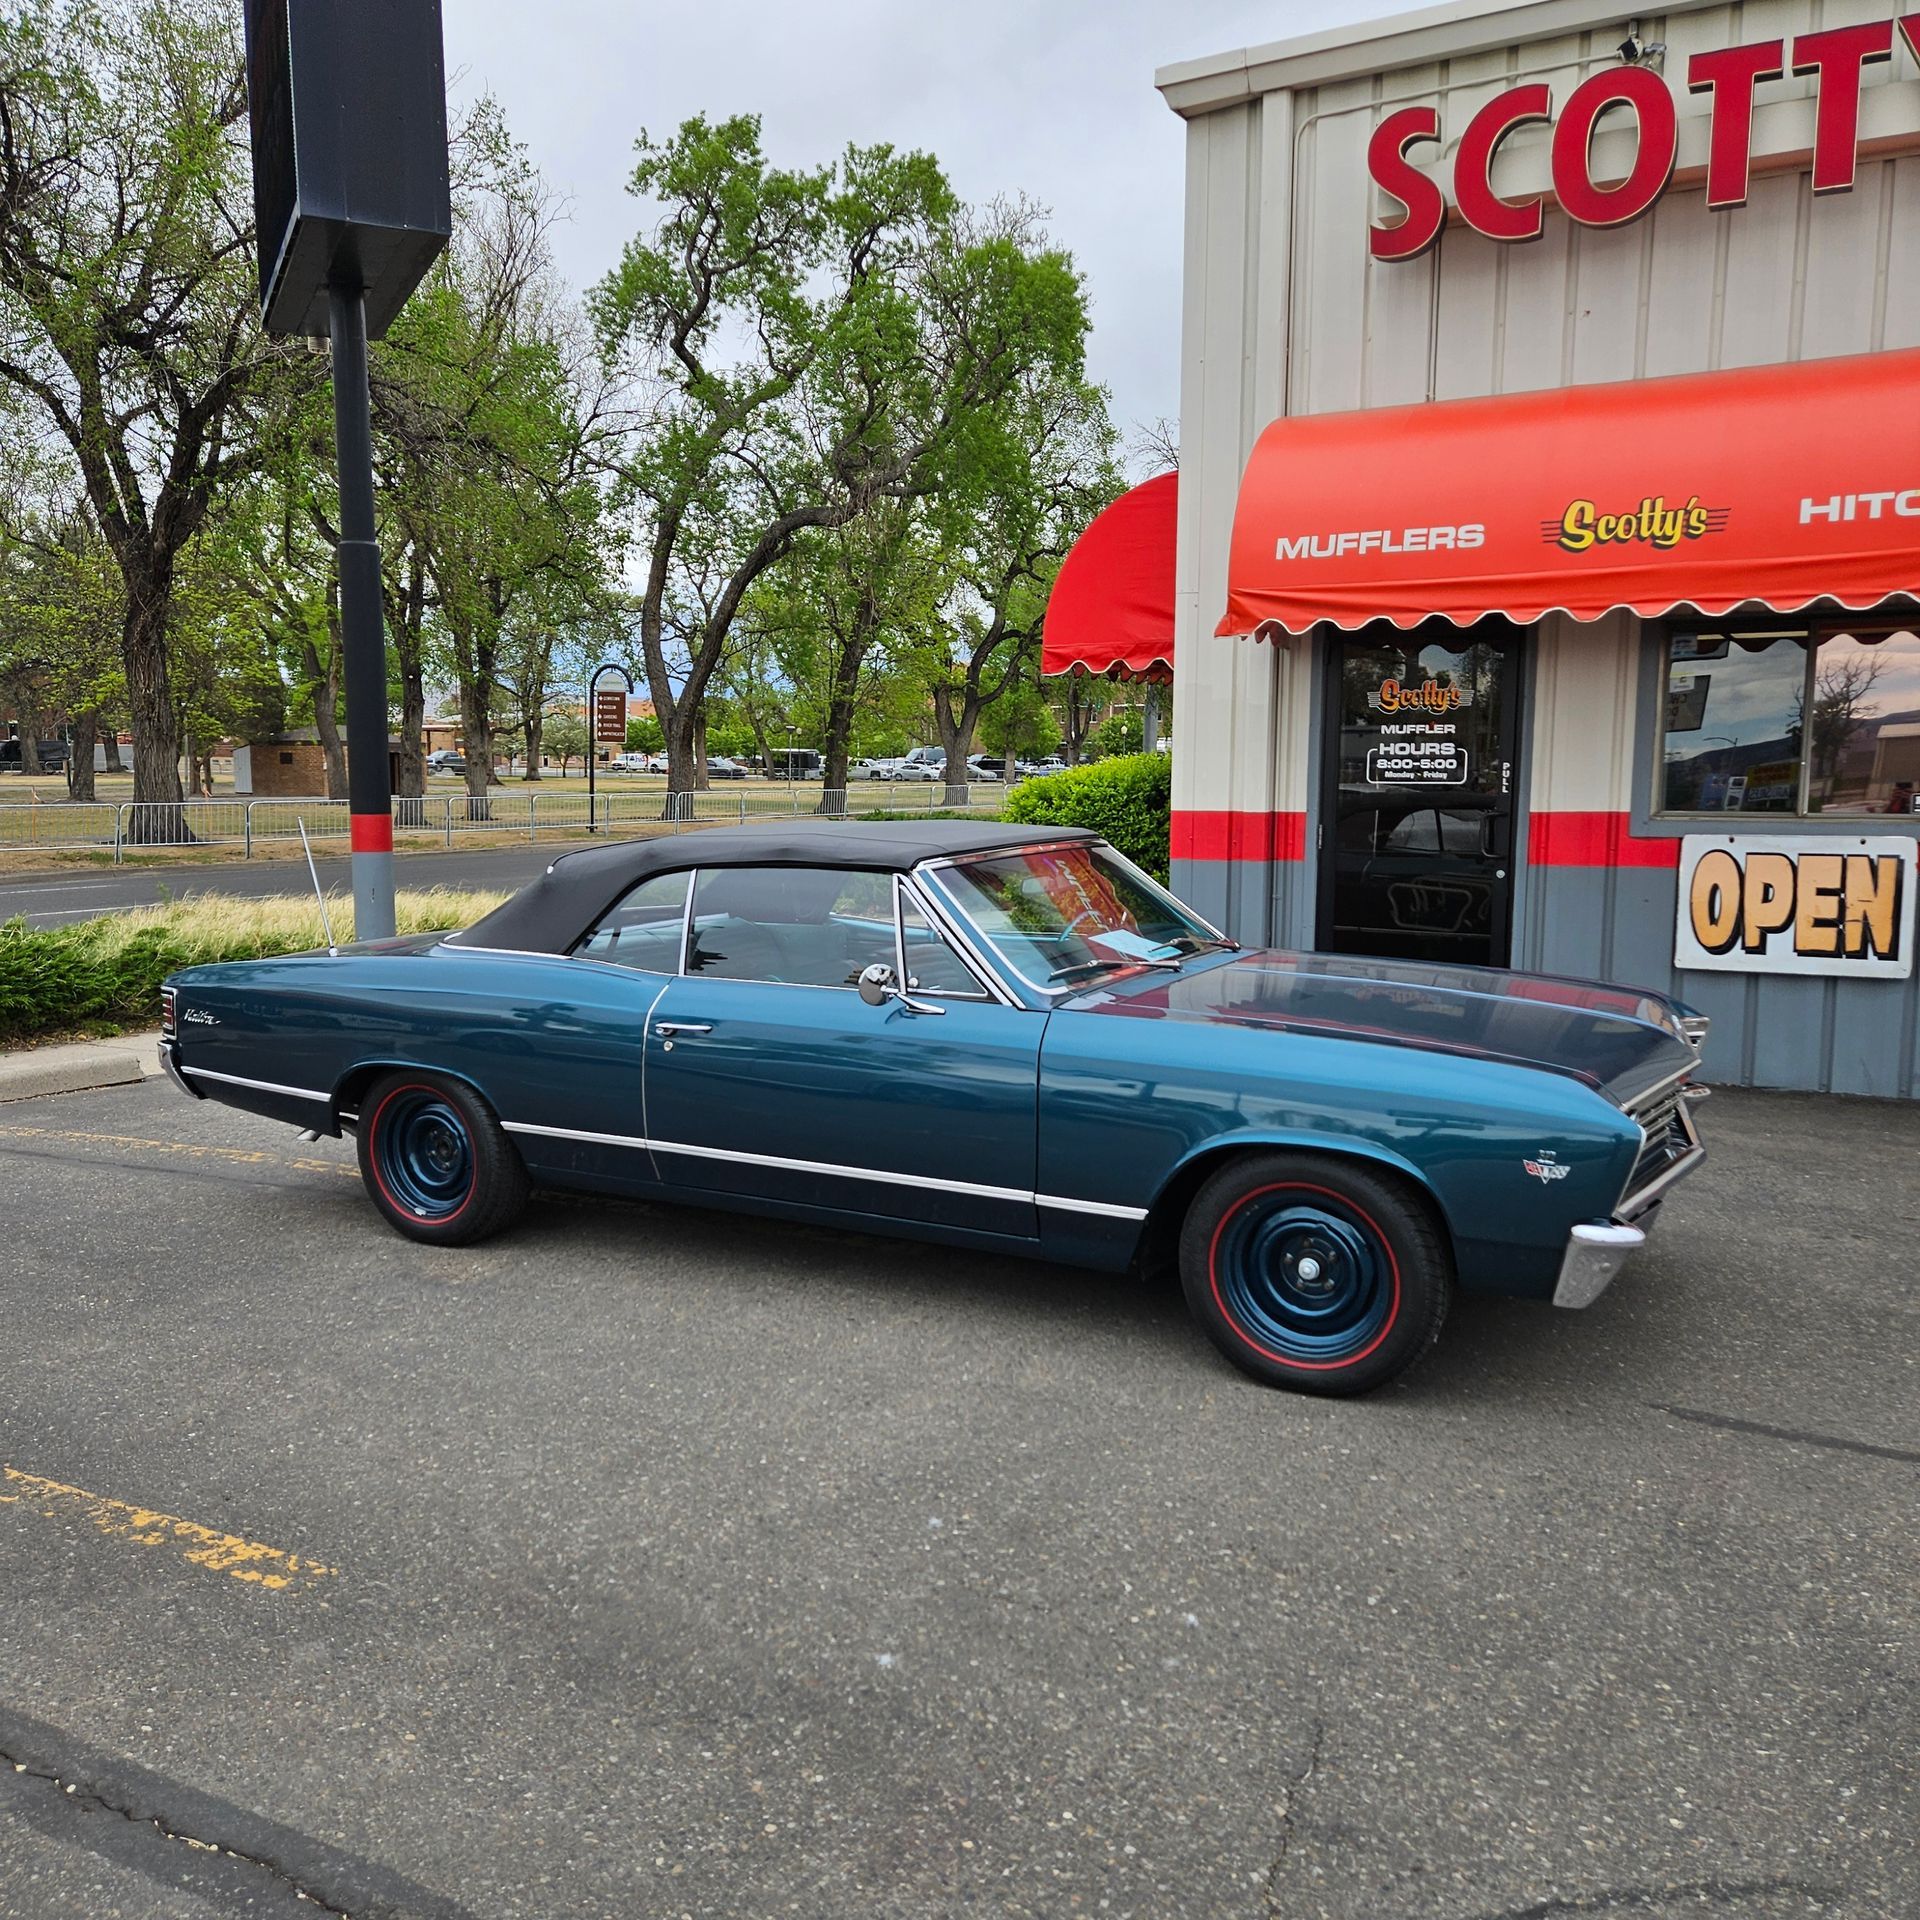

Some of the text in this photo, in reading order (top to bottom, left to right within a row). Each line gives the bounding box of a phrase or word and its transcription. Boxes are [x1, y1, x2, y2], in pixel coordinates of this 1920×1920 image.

[1368, 10, 1920, 263] SCOTT
[1558, 495, 1709, 553] Scotty's
[1275, 524, 1485, 560] MUFFLERS
[1377, 679, 1462, 715] Scotty's
[1381, 724, 1456, 735] MUFFLER
[1376, 759, 1458, 769] 8:00-5:00
[1379, 743, 1456, 756] HOURS
[1384, 771, 1415, 779] Monday
[1423, 771, 1448, 779] Friday
[1502, 762, 1511, 793] PULL
[1690, 848, 1905, 961] OPEN
